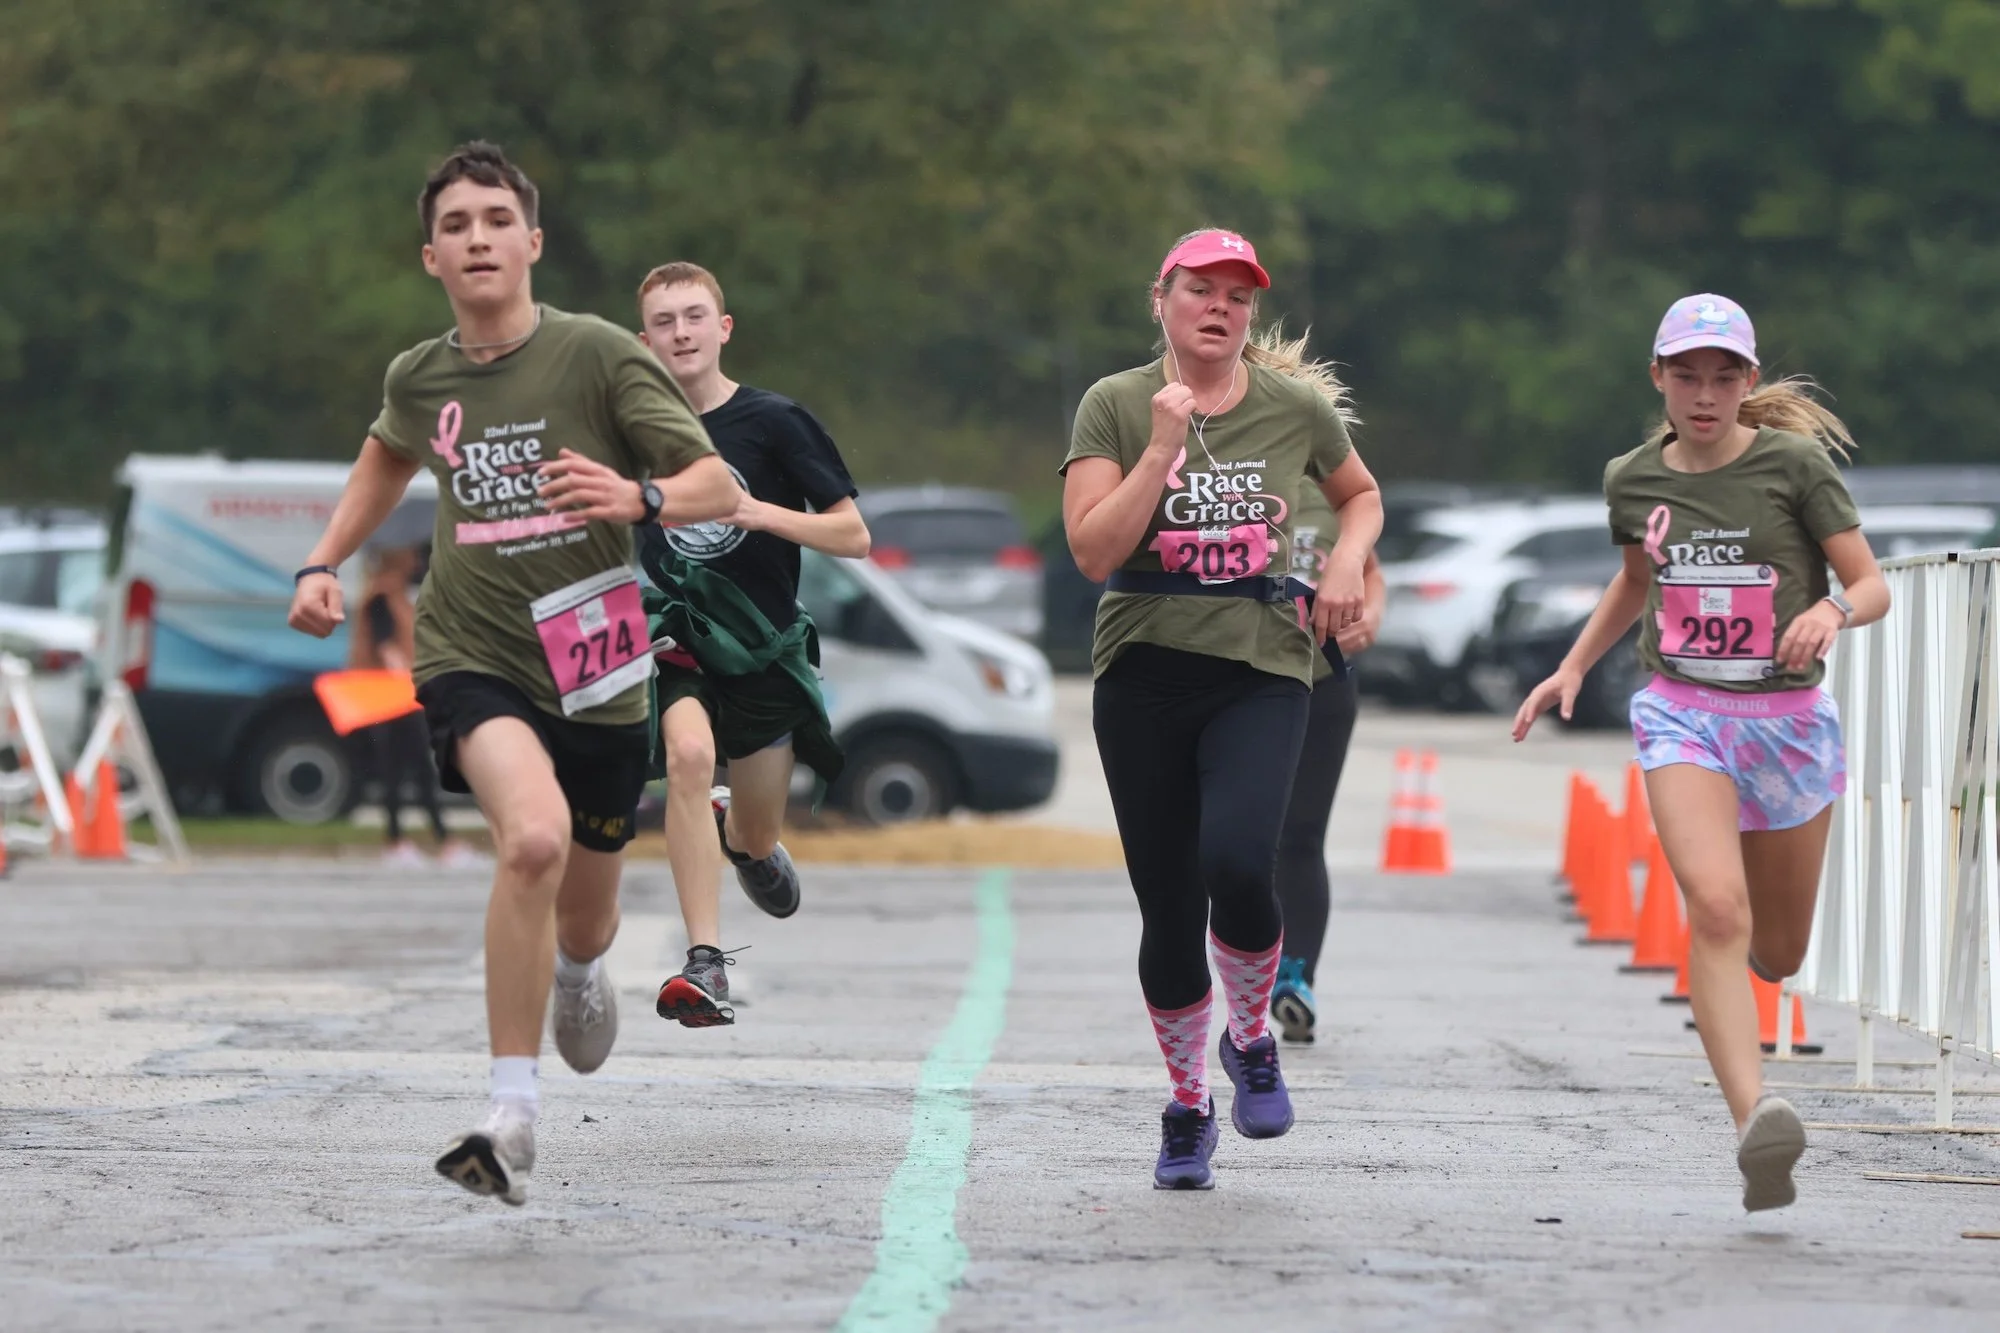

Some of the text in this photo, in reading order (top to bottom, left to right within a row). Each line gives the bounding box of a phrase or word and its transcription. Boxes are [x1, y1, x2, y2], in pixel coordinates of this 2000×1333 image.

[484, 417, 547, 438] 22nd Annual
[462, 437, 542, 482] Race
[1234, 459, 1266, 469] Annual
[1187, 473, 1263, 504] Race
[1165, 493, 1265, 524] Grace
[1691, 527, 1750, 540] 22nd Annual
[1176, 542, 1250, 577] 203
[1667, 543, 1745, 566] Race
[569, 618, 634, 684] 274
[1678, 617, 1753, 655] 292
